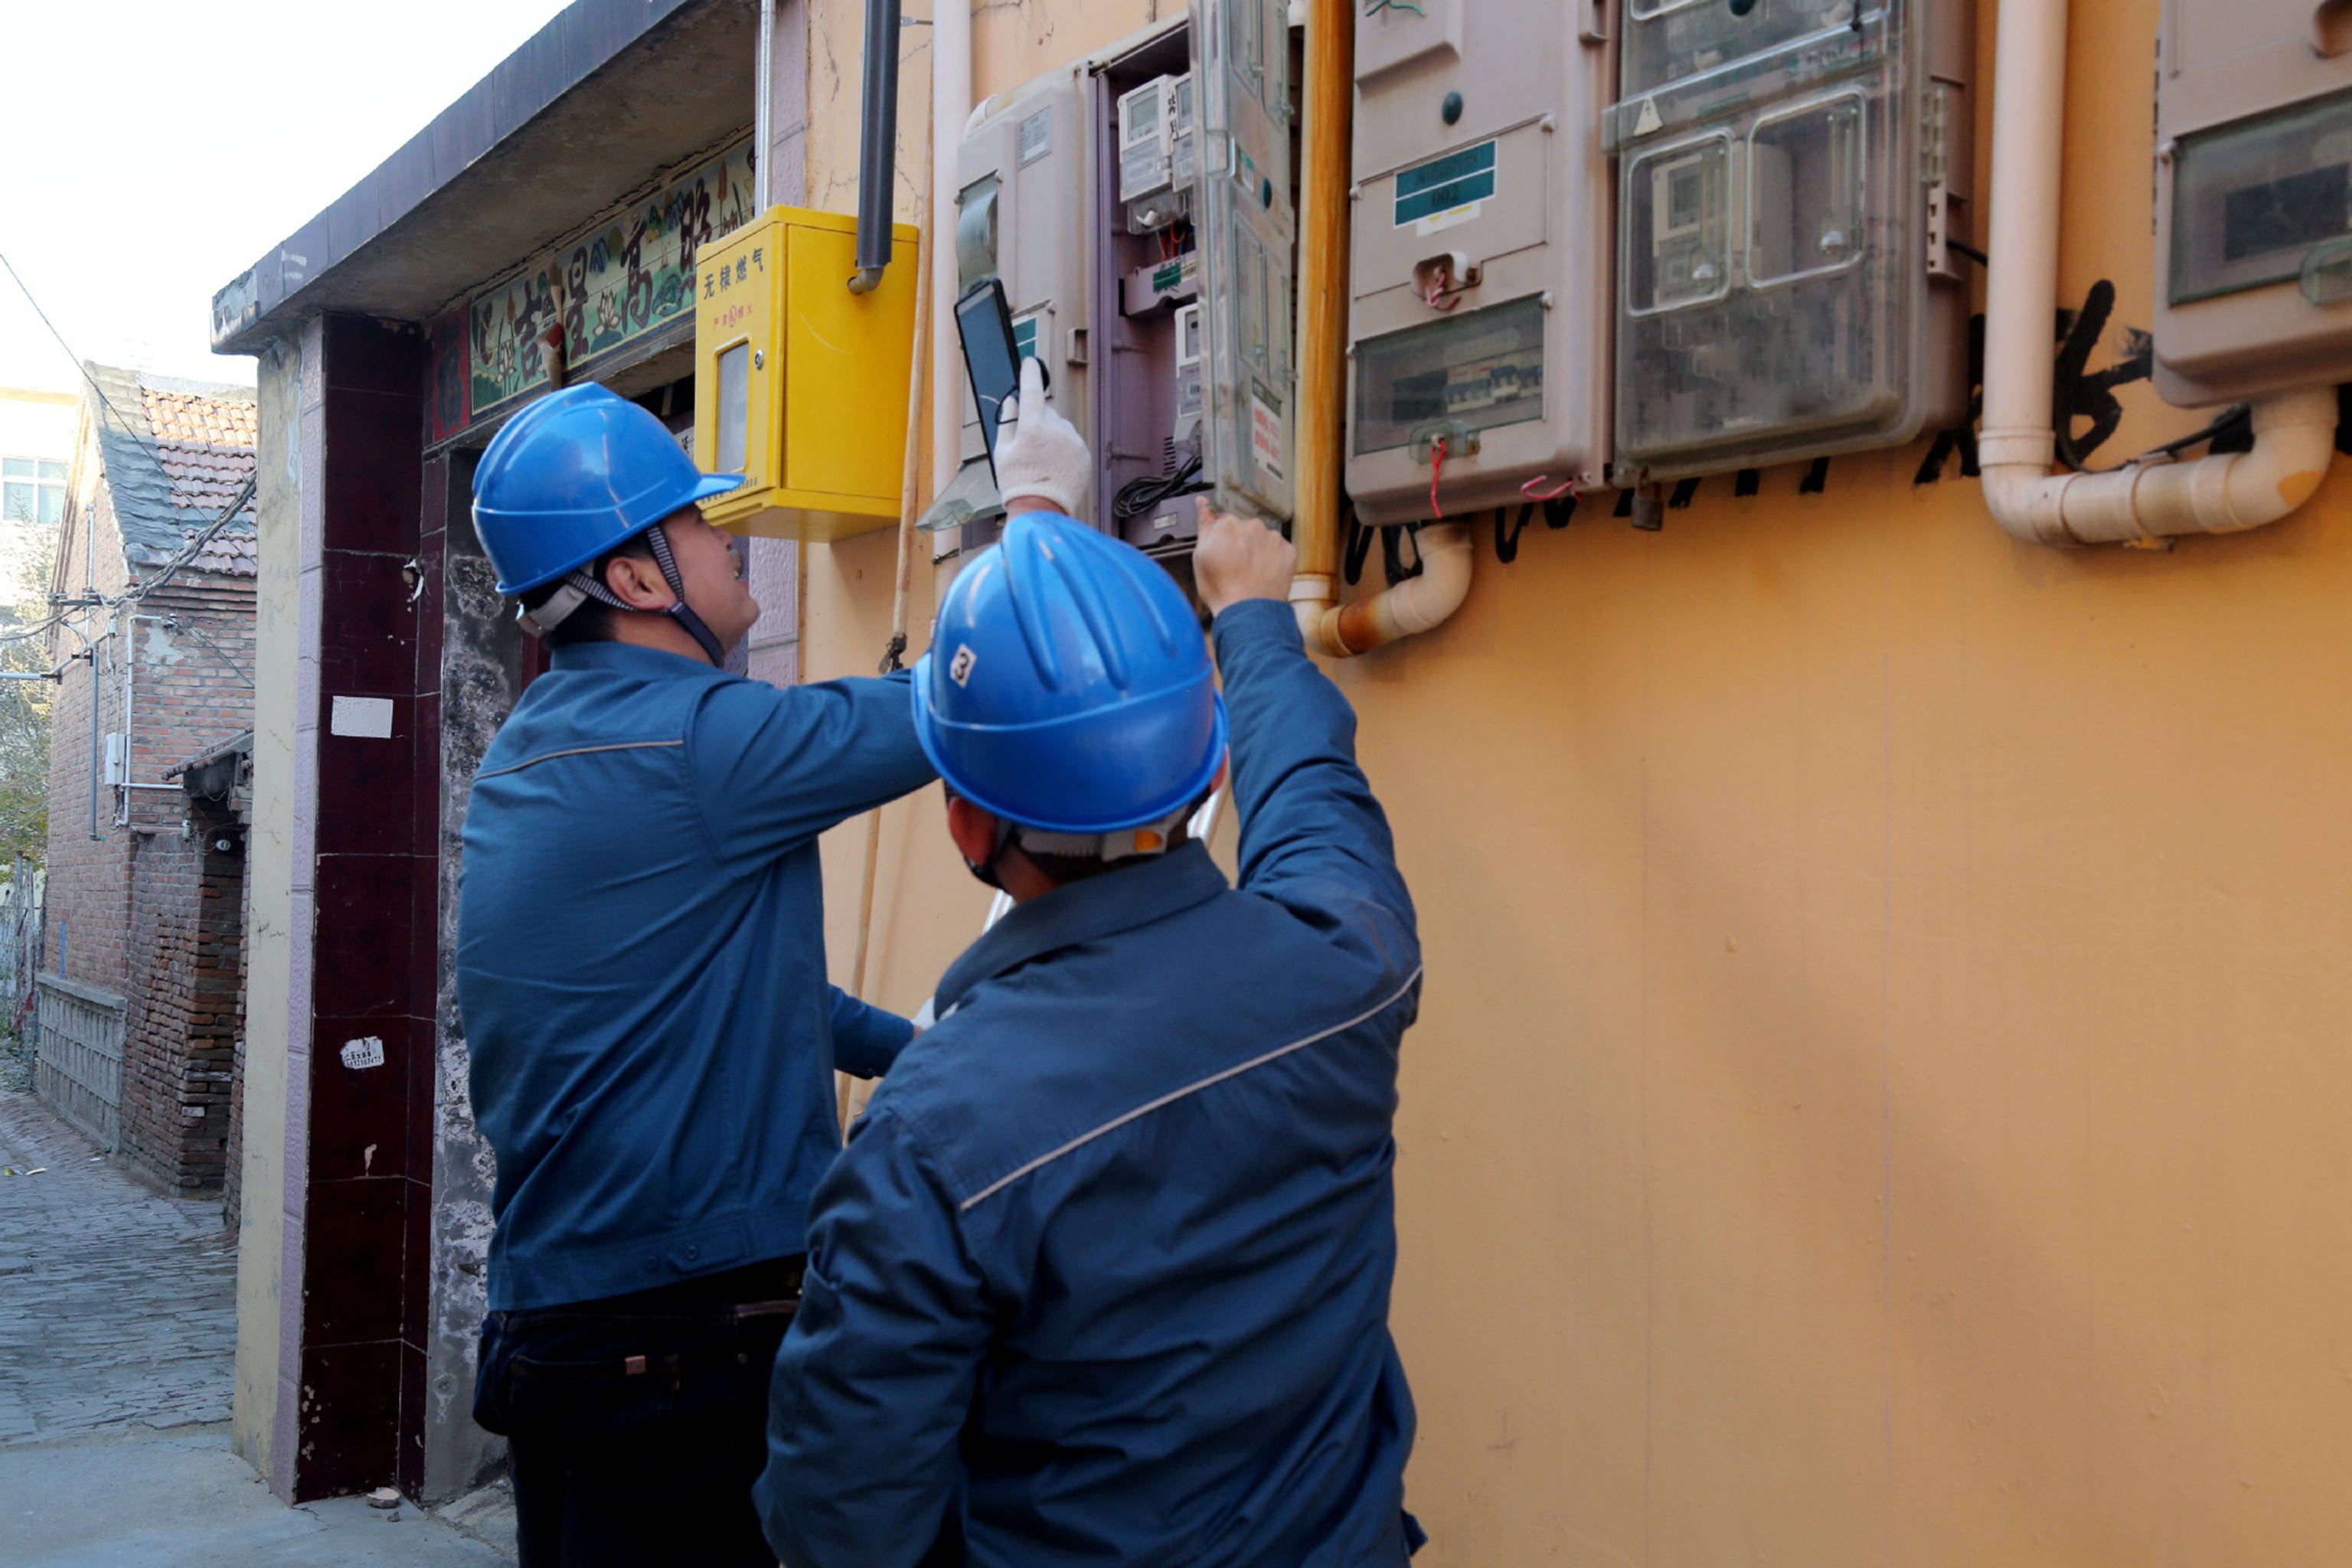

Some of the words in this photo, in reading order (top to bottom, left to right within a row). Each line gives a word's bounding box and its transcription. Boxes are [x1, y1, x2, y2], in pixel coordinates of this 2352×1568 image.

[703, 247, 763, 300] 无棣燃气
[954, 652, 969, 681] 3
